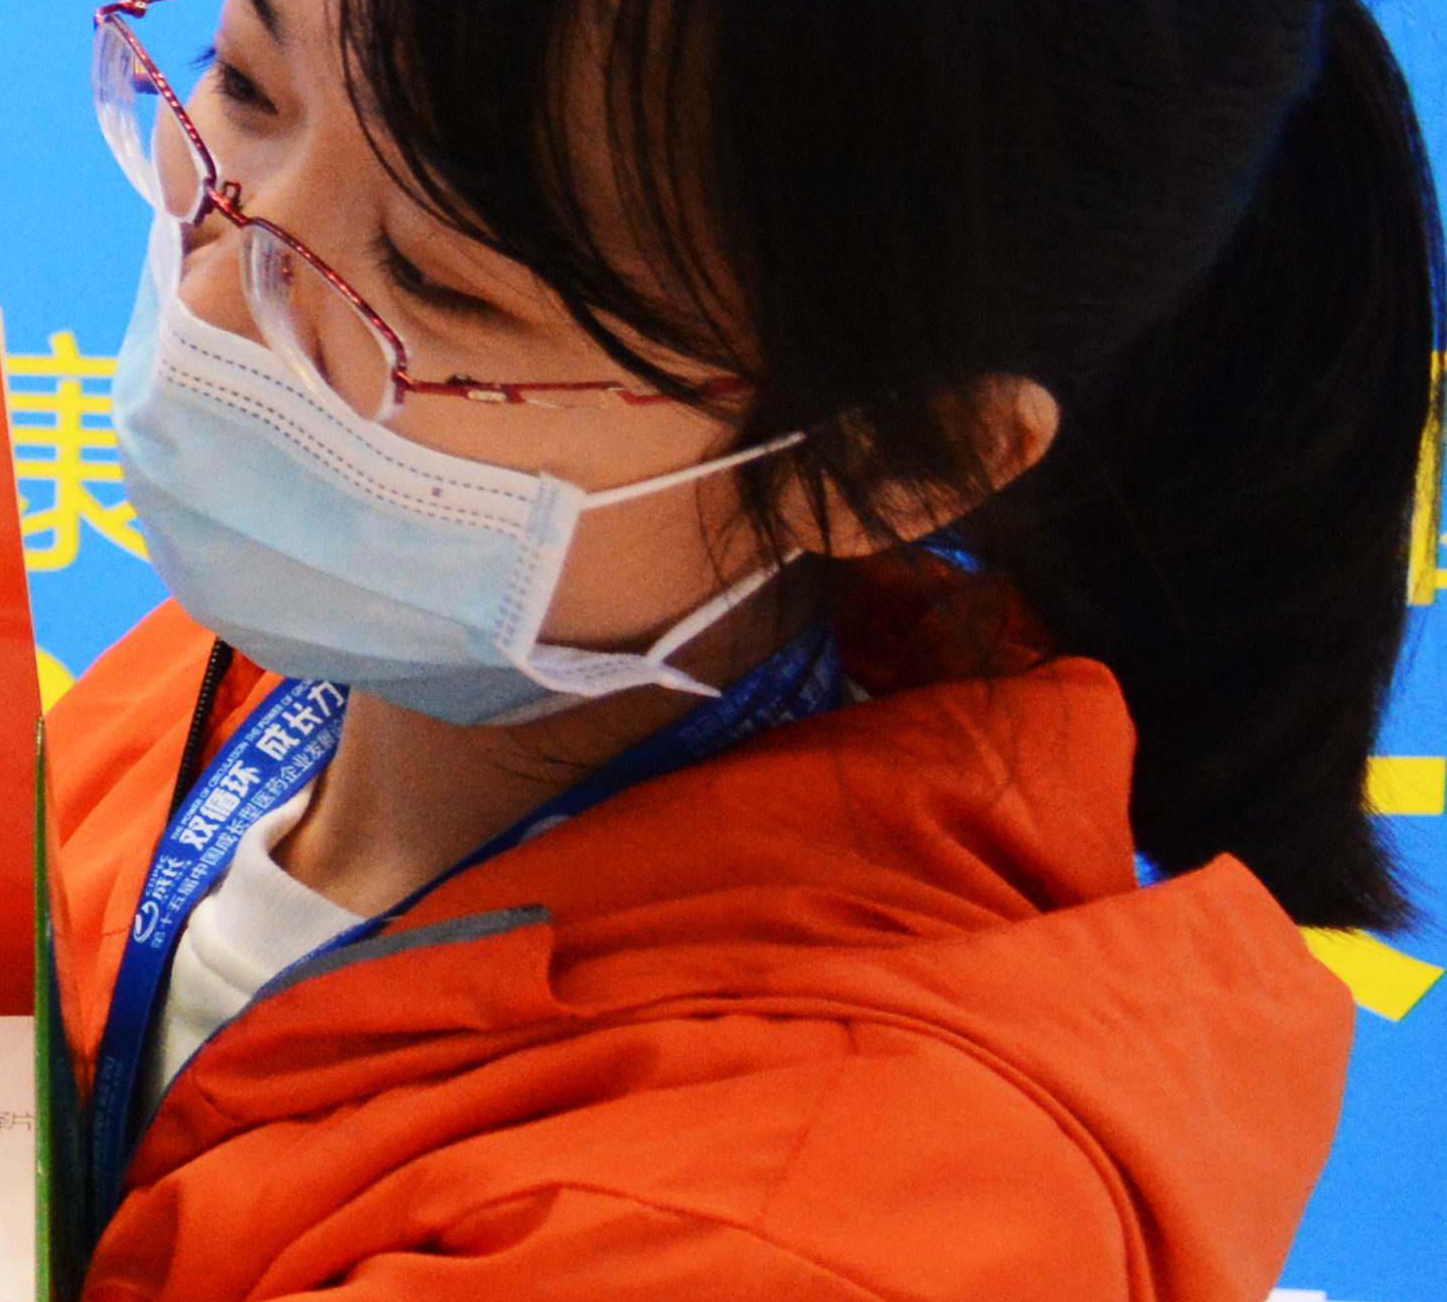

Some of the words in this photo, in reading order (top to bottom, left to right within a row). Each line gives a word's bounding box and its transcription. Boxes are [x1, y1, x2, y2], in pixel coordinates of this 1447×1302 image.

[179, 760, 261, 850] 双循环
[256, 682, 345, 761] 成长力
